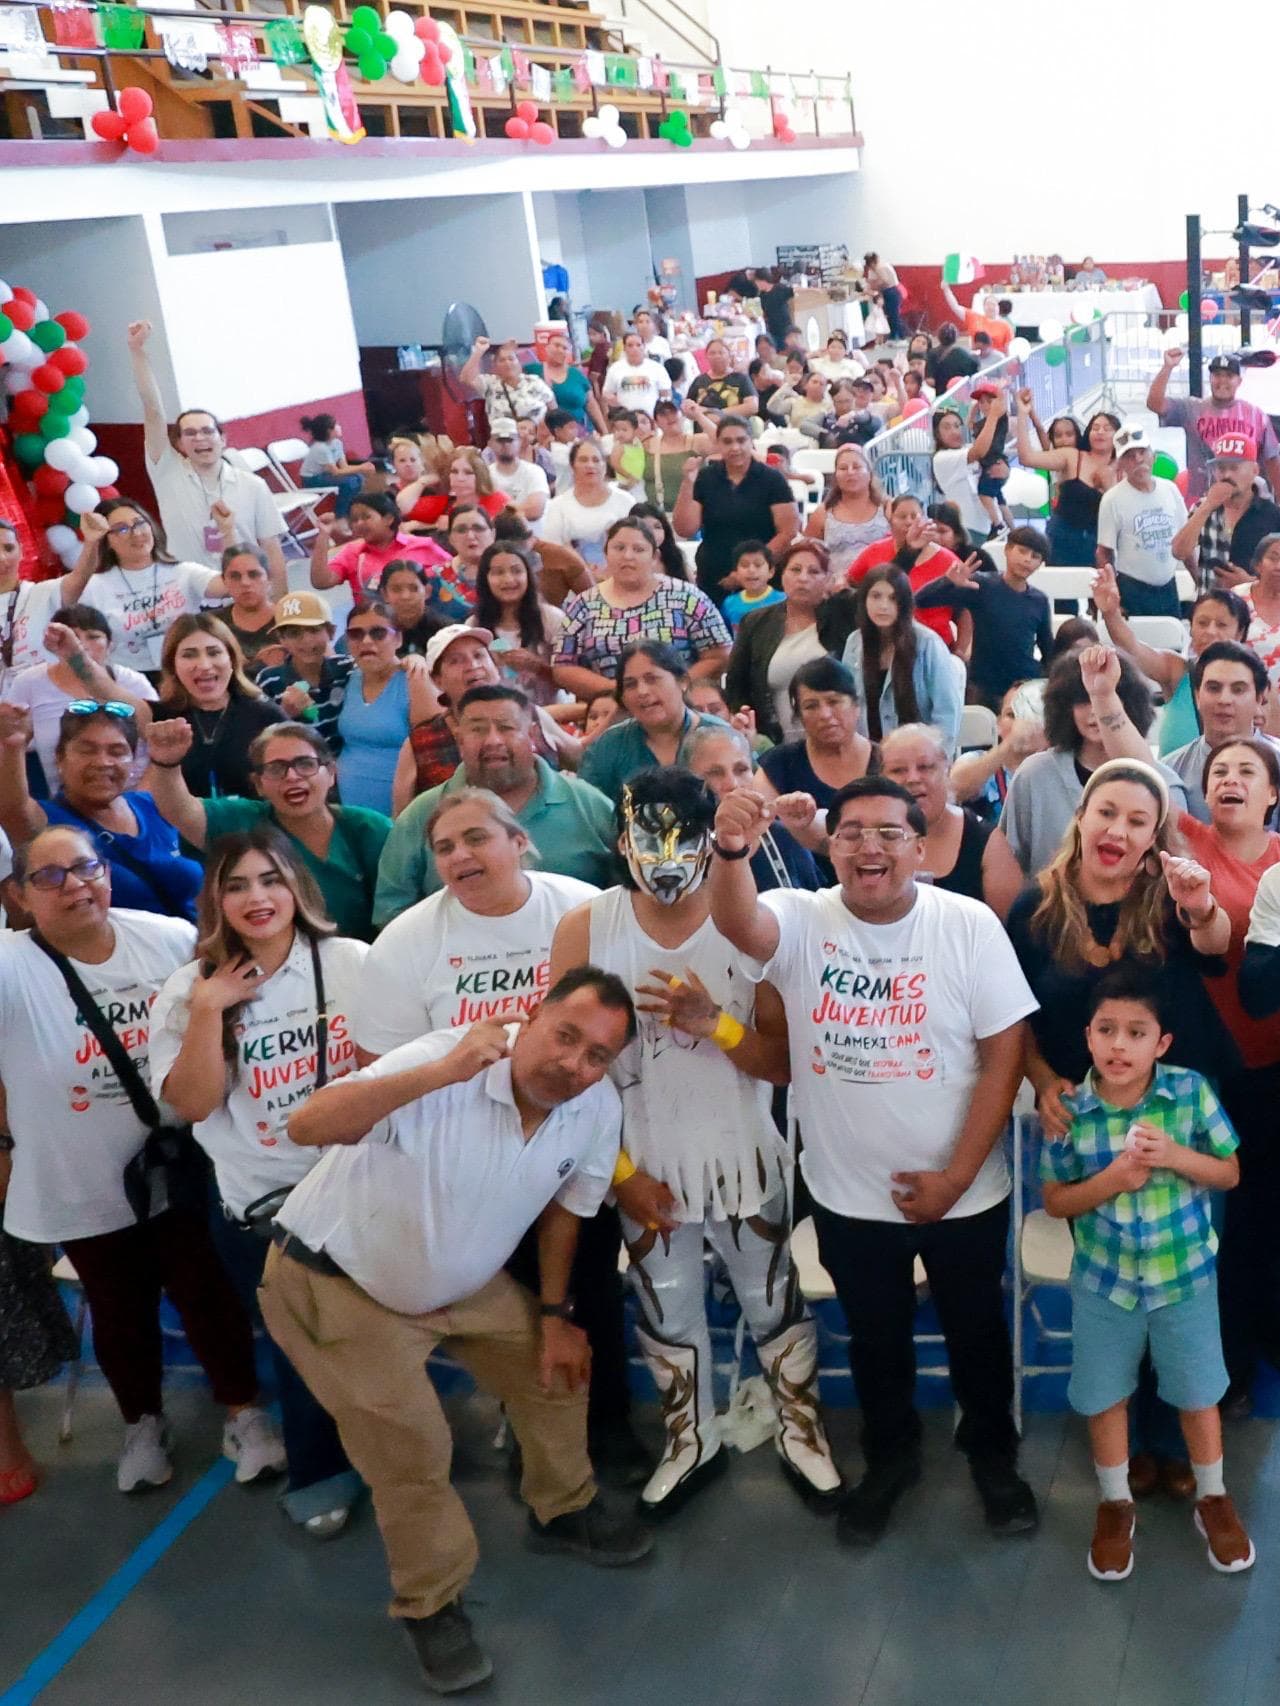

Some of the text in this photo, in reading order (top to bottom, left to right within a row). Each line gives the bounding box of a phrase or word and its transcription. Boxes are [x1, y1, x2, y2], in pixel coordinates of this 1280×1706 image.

[820, 963, 926, 1001] KERMÉS
[812, 991, 927, 1028] JUVENTUD
[243, 1014, 348, 1065] KERMS
[248, 1040, 354, 1099] JUVENUD
